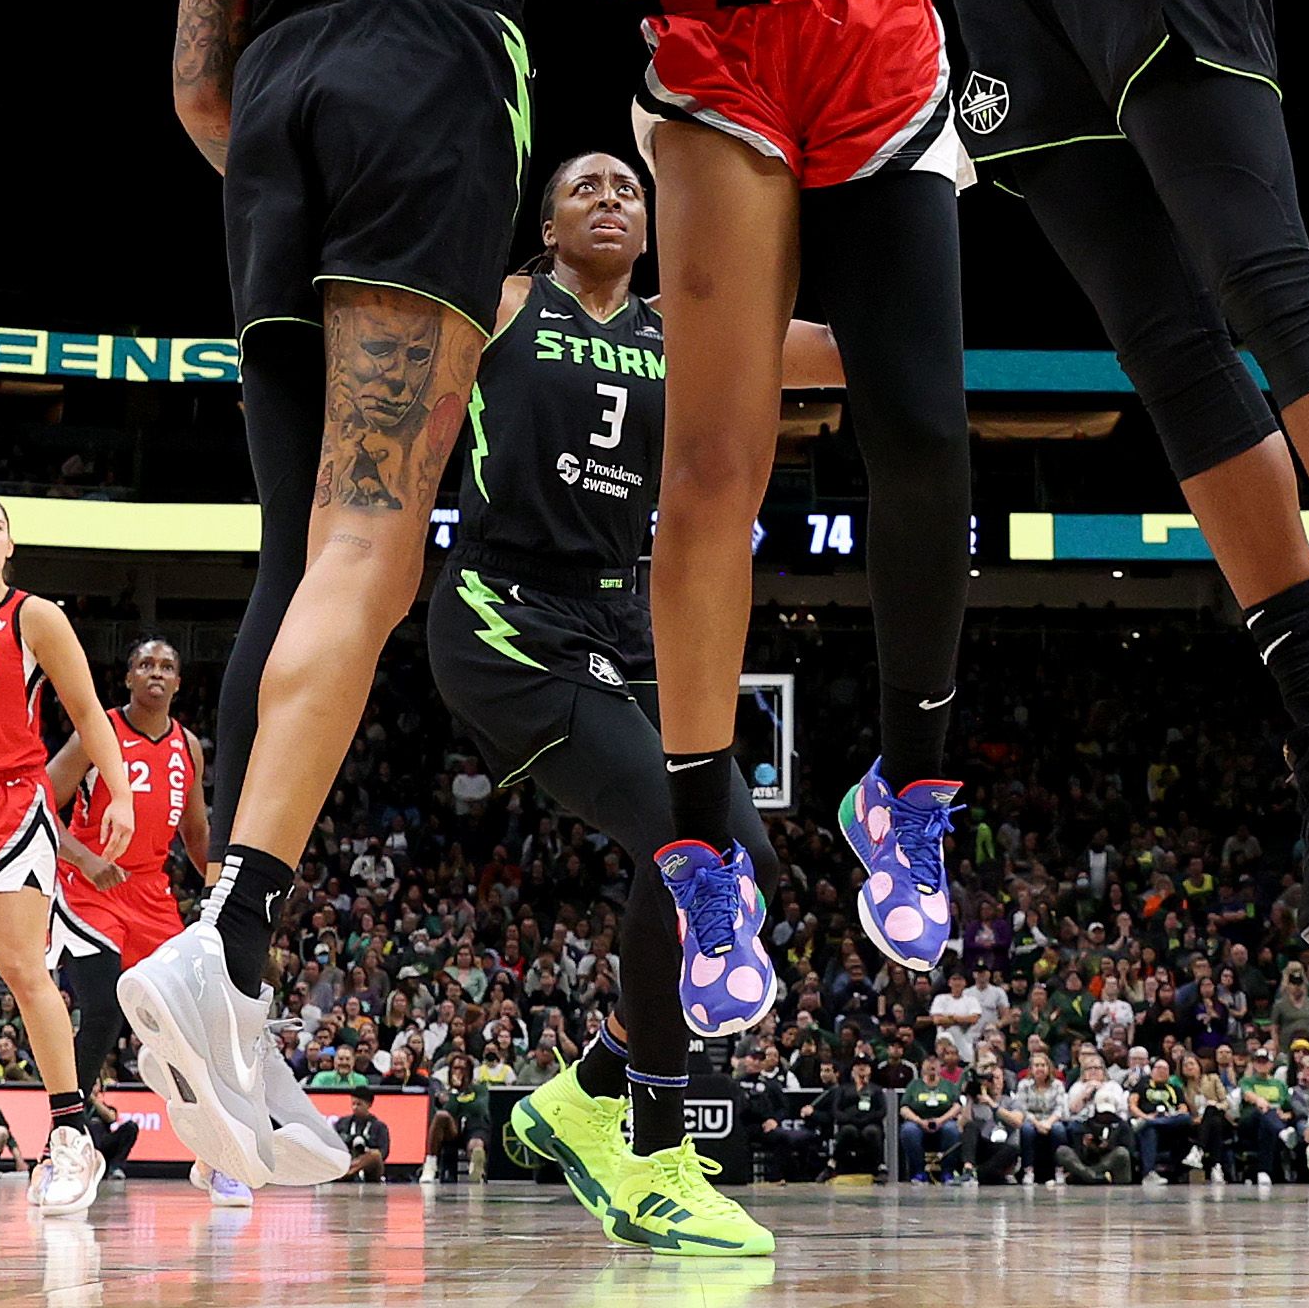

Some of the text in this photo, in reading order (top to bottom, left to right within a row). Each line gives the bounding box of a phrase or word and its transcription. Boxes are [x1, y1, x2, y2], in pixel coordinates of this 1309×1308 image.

[534, 329, 666, 380] STORM
[589, 382, 628, 449] 3
[581, 477, 630, 500] SWEDISH
[585, 458, 644, 487] Providence
[807, 514, 854, 555] 74
[167, 752, 186, 827] ACES
